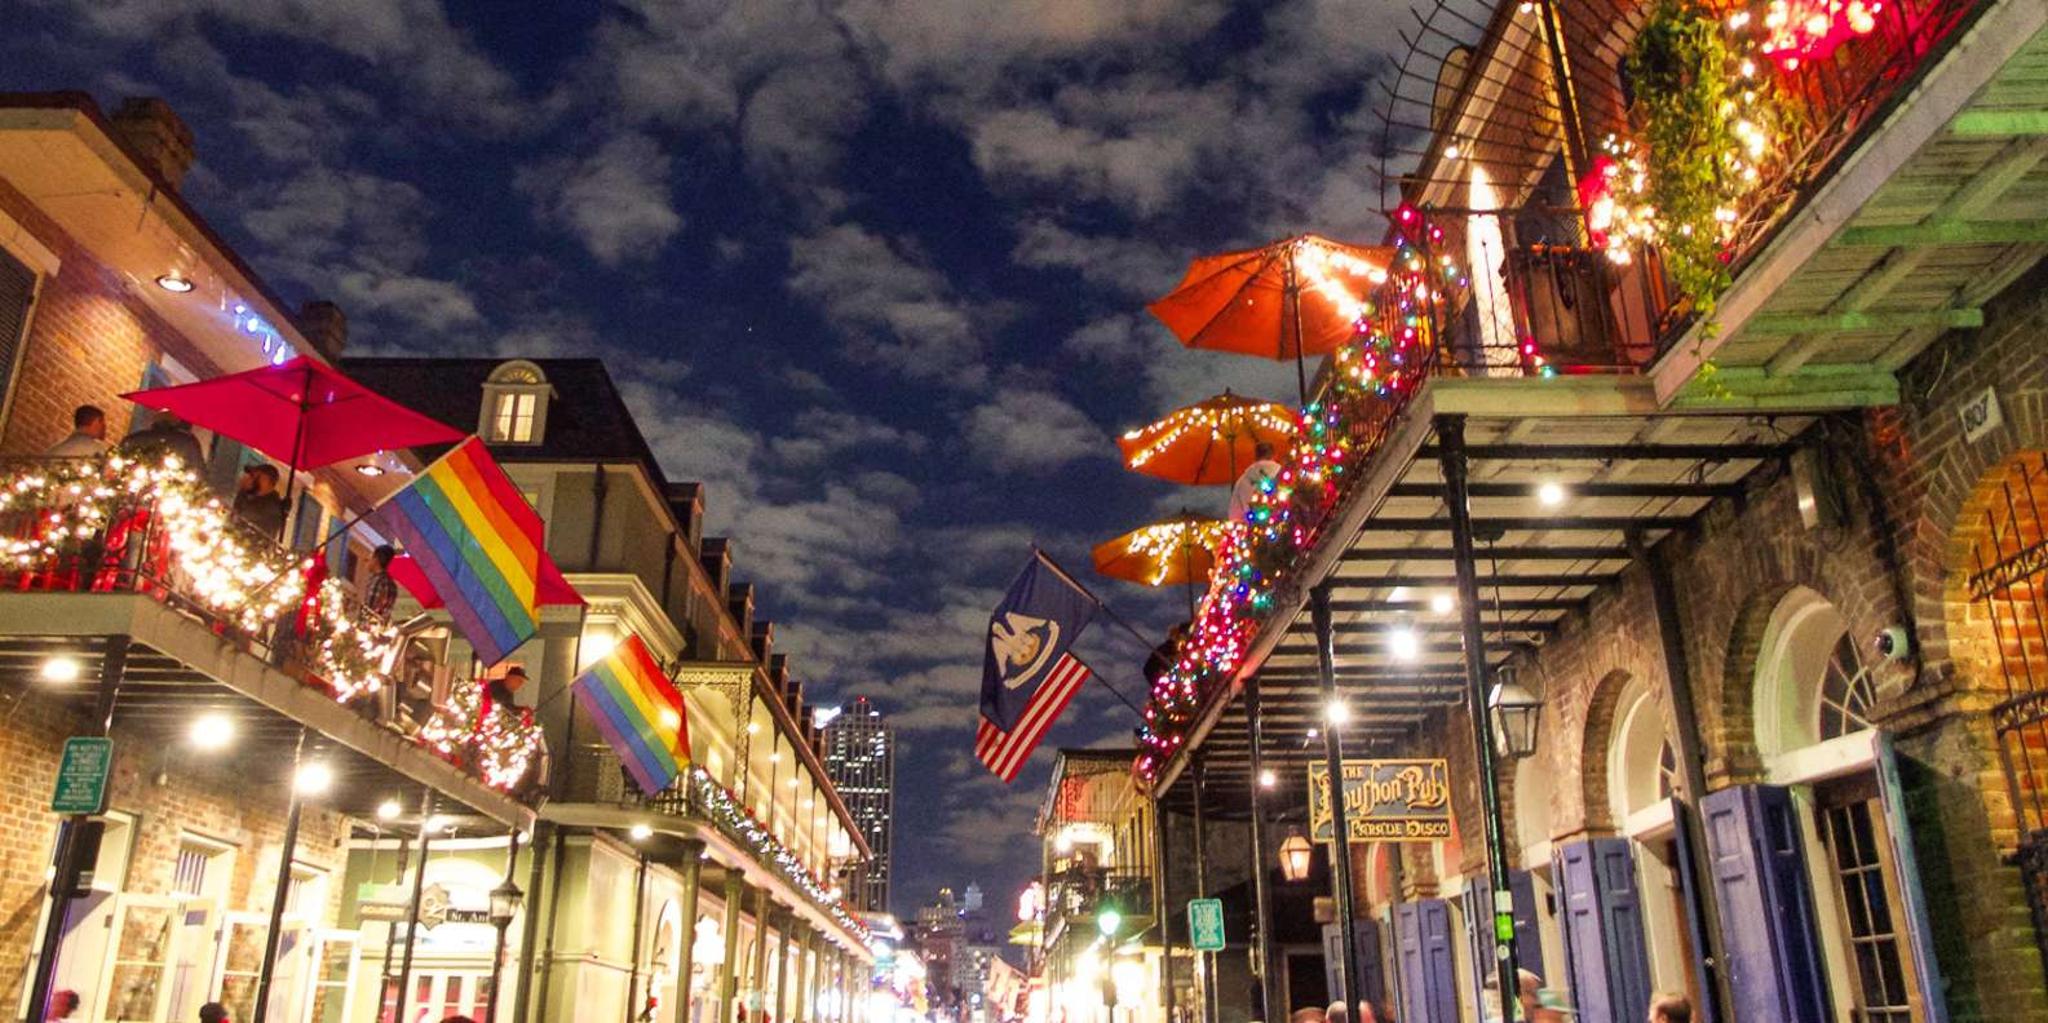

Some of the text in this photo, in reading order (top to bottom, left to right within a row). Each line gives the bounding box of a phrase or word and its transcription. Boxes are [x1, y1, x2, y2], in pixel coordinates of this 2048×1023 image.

[1963, 394, 1988, 432] 807
[1343, 765, 1364, 779] THE
[1395, 762, 1447, 810] Pub
